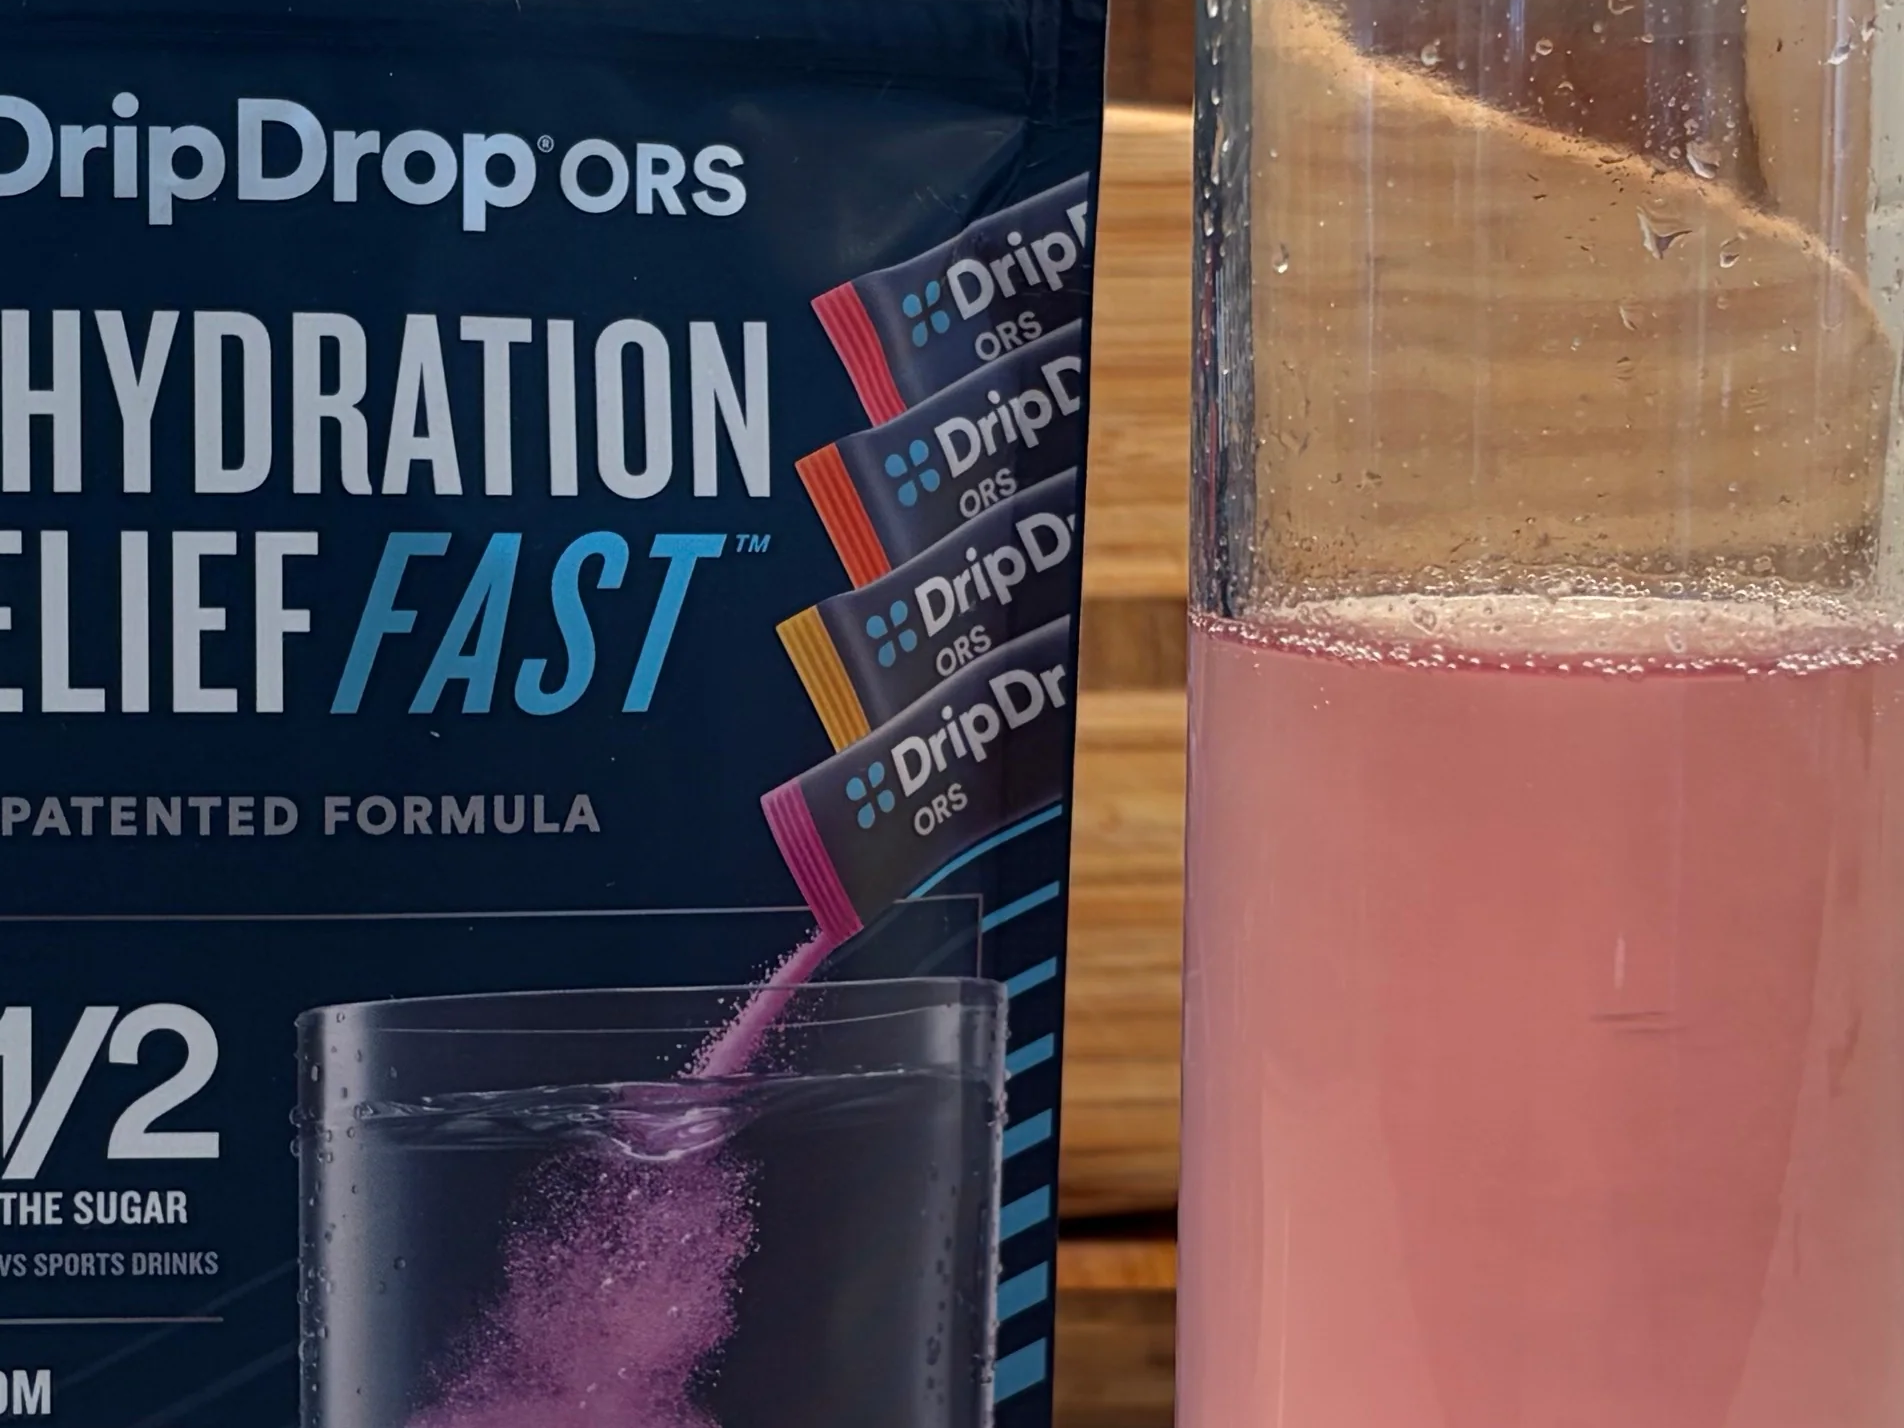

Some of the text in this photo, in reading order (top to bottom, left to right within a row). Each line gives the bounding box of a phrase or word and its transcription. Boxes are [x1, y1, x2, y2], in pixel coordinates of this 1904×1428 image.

[559, 138, 747, 217] ORS
[975, 311, 1043, 361] ORS
[959, 467, 1017, 518] ORS
[915, 512, 1076, 637] DripD
[936, 624, 992, 677] ORS
[0, 794, 601, 837] PATENTED FORMULA
[913, 782, 969, 835] ORS
[74, 1191, 188, 1225] SUGAR
[34, 1252, 124, 1277] SPORTS
[132, 1250, 218, 1276] DRINKS
